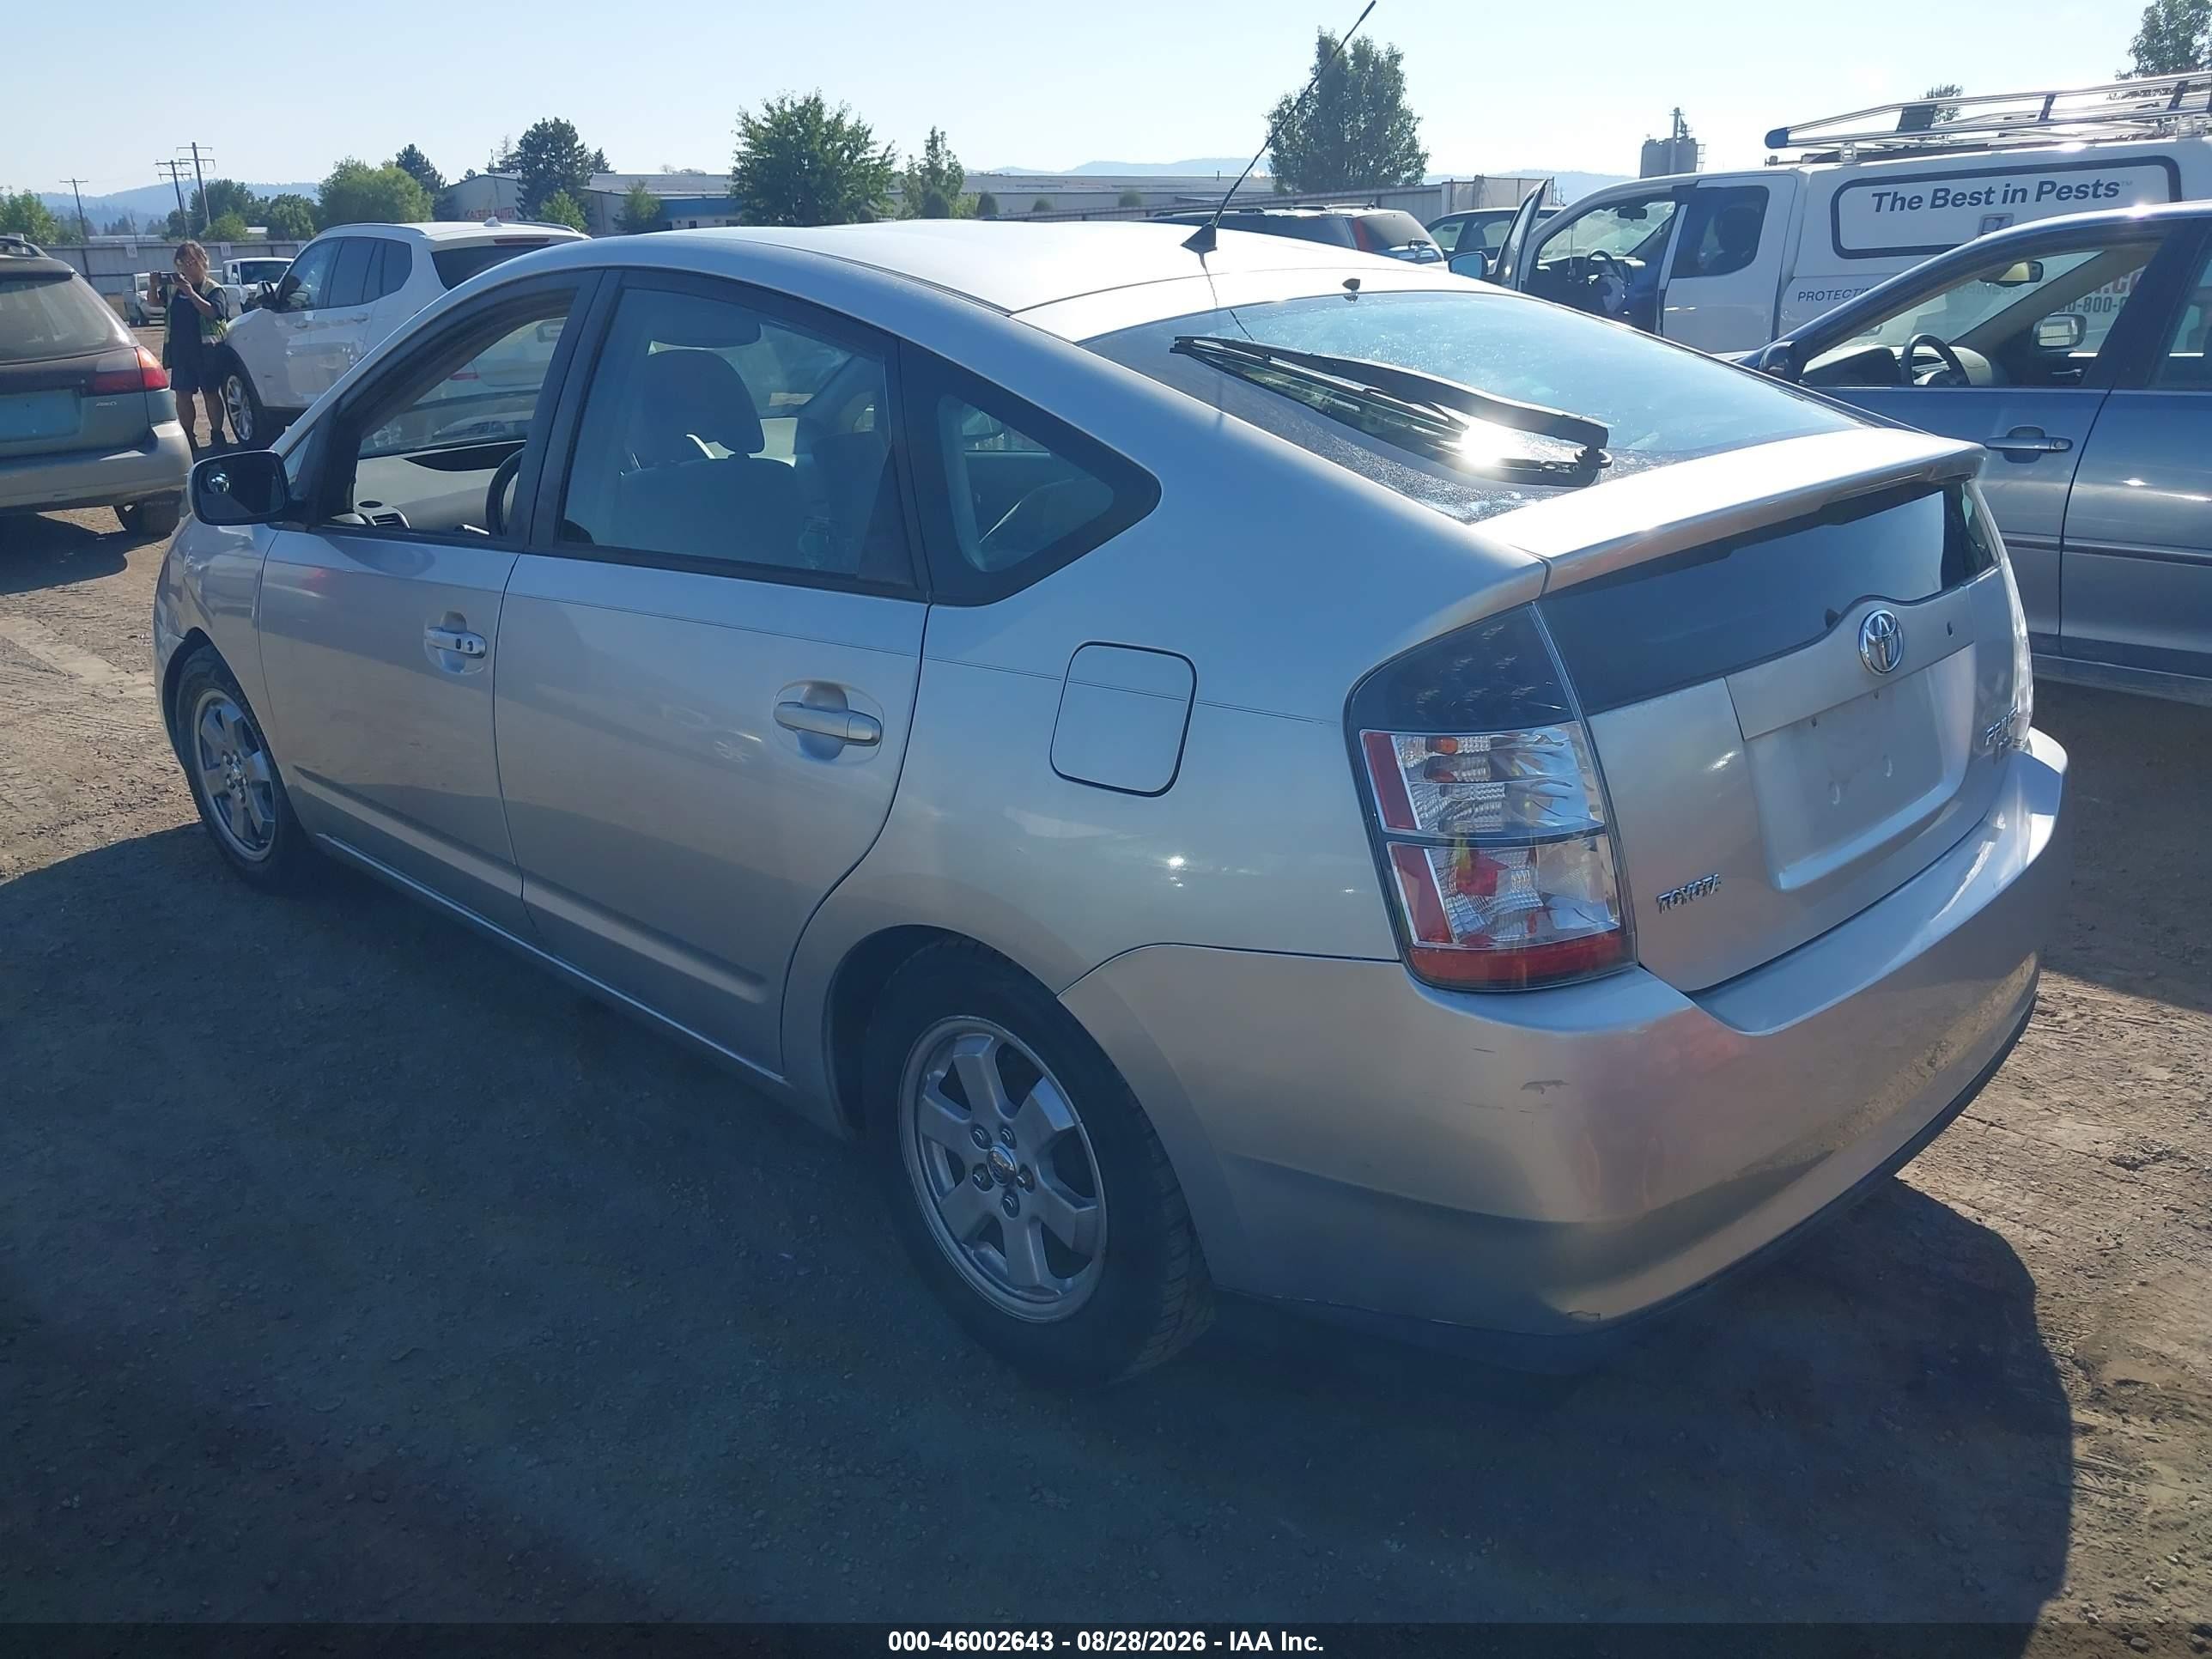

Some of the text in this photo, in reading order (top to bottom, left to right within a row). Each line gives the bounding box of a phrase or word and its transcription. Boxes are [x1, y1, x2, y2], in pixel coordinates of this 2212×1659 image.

[1871, 191, 1923, 213] The
[1929, 185, 1996, 210] Best
[2001, 183, 2027, 204] in
[2034, 179, 2120, 203] Pests
[1798, 288, 1870, 302] PROTECTI
